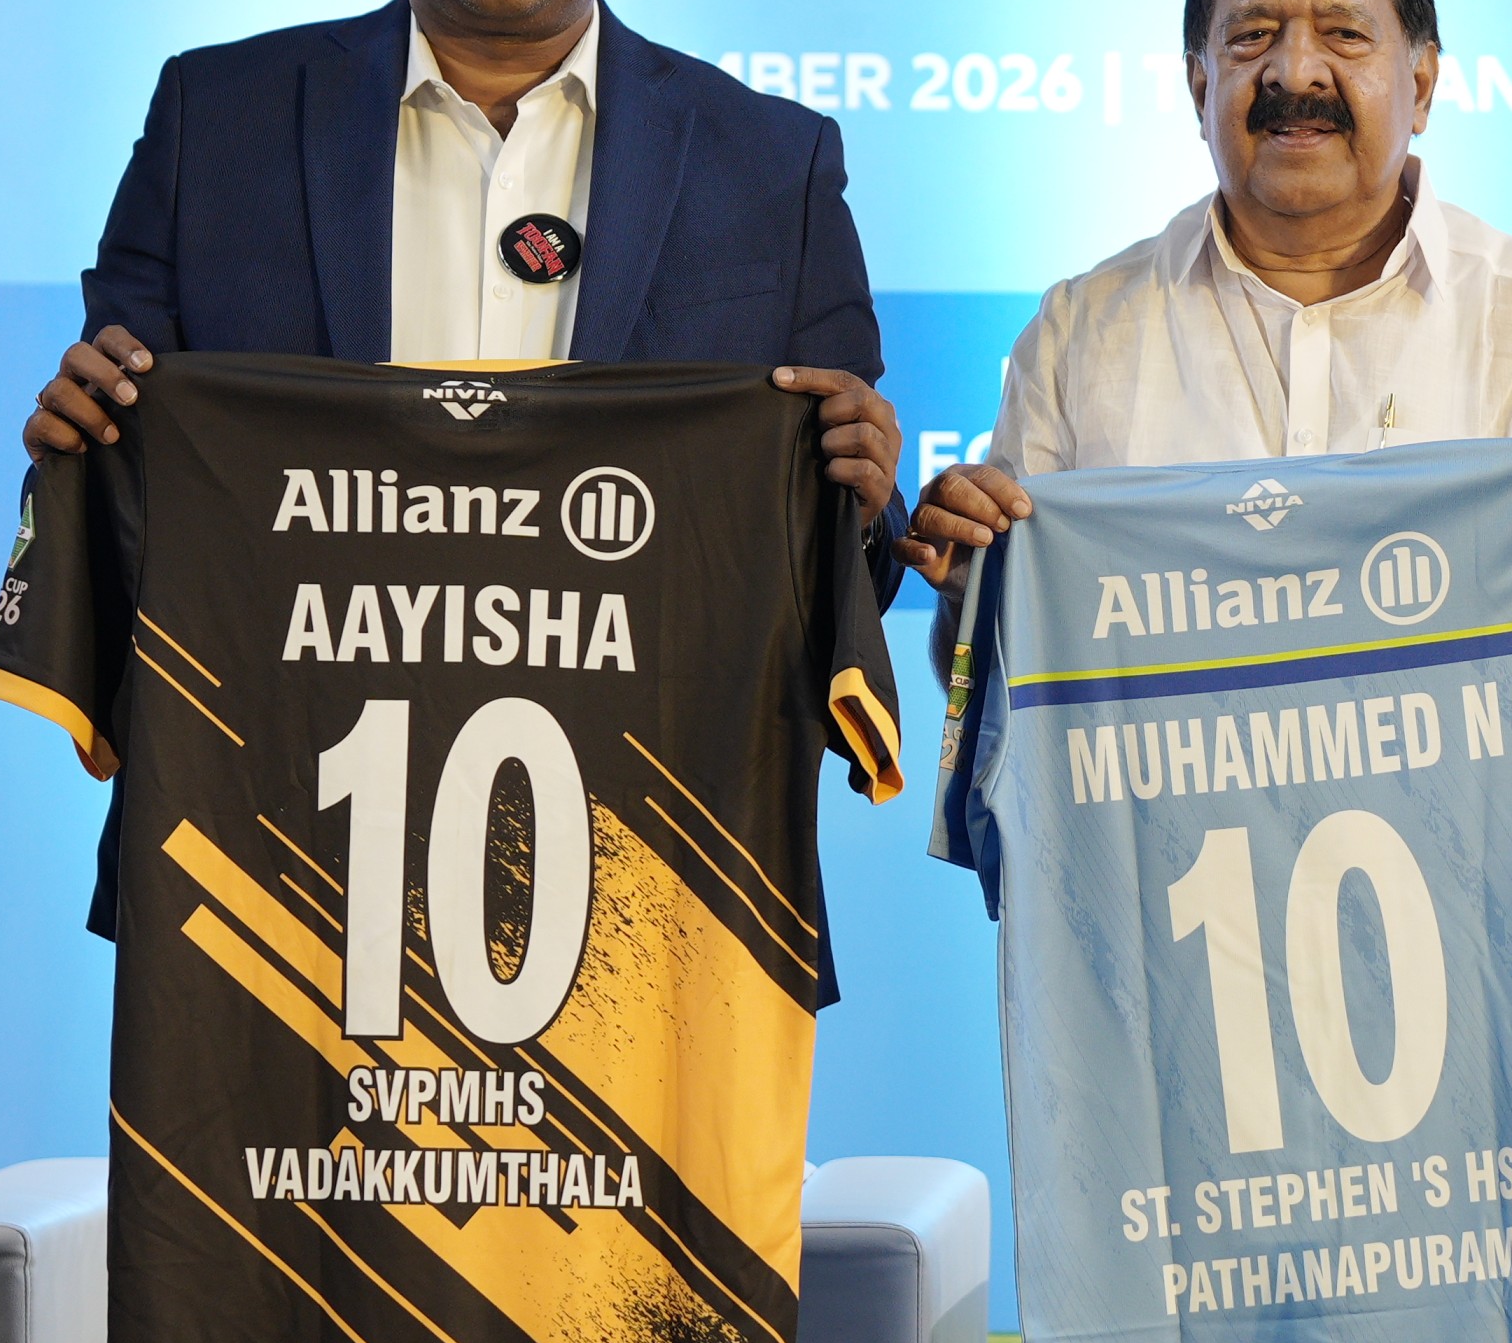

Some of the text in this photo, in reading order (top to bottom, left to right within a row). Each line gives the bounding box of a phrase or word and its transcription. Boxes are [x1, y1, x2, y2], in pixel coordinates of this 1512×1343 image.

[909, 52, 1083, 113] 2026
[423, 387, 507, 403] NIVIA
[273, 468, 540, 538] Allianz
[1226, 492, 1304, 515] NIVIA
[5, 577, 29, 595] CUP
[1092, 566, 1343, 639] Allianz
[282, 582, 637, 673] AAYISHA
[1067, 679, 1505, 806] MUHAMMED N
[316, 696, 596, 1045] 10
[1166, 808, 1448, 1156] 10
[346, 1065, 546, 1126] SVPMHS
[244, 1146, 643, 1208] VADAKKUMTHALA
[1120, 1186, 1181, 1244] ST.
[1197, 1160, 1396, 1235] STEPHEN
